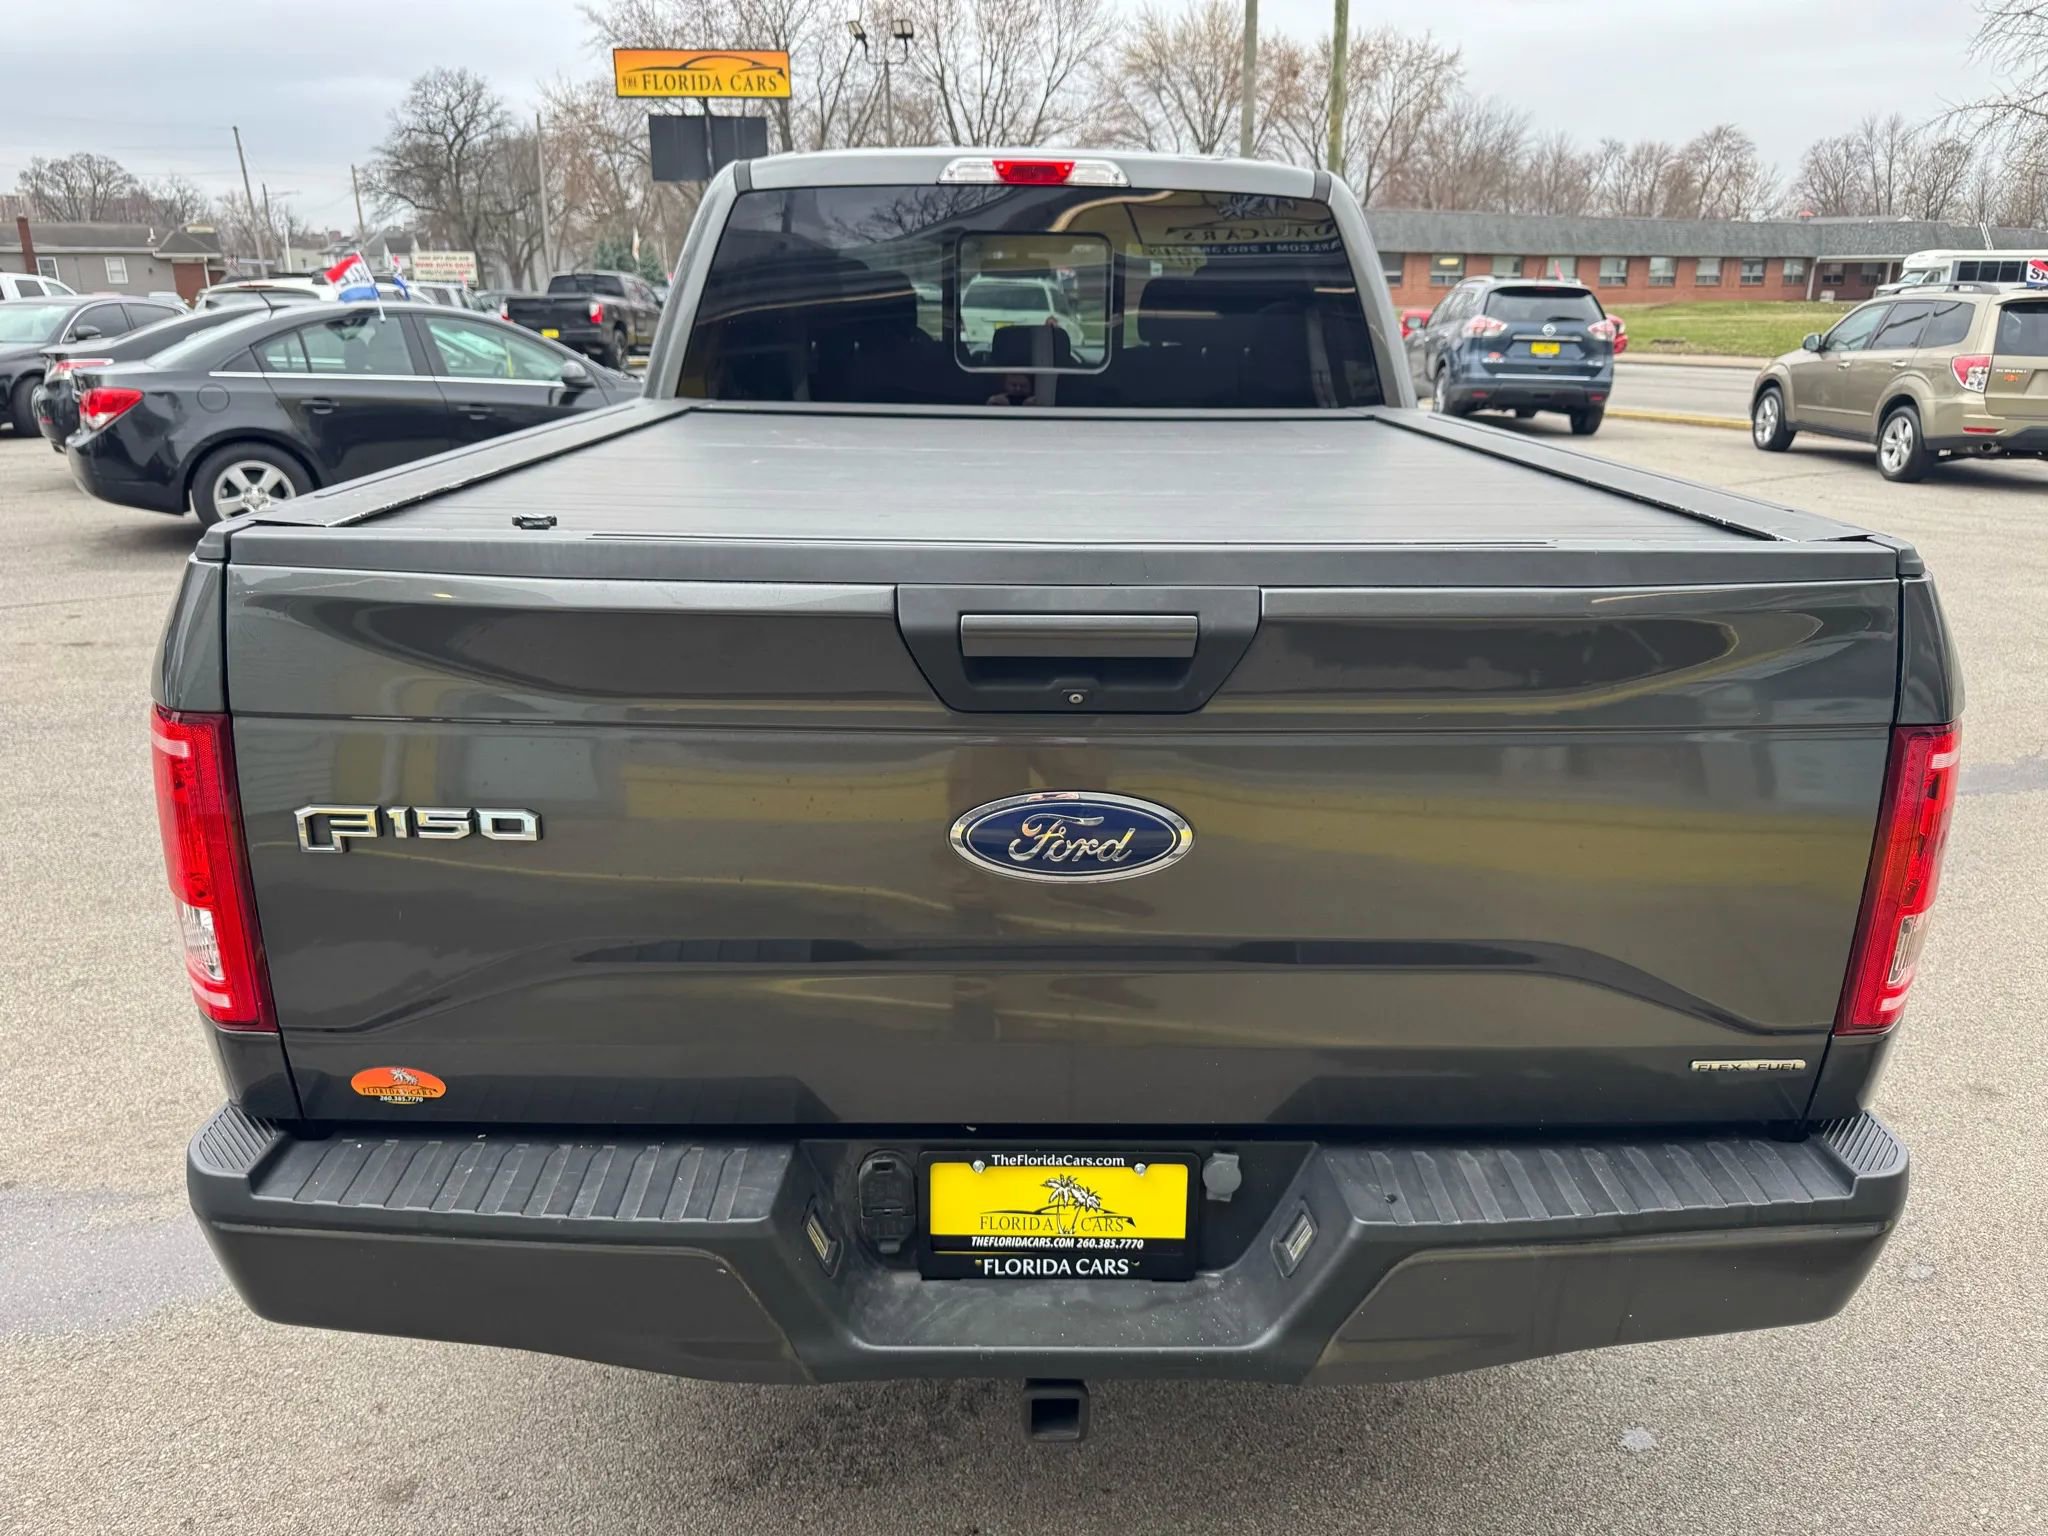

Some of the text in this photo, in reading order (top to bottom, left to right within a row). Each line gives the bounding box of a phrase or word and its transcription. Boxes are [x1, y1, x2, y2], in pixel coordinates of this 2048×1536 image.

[642, 74, 723, 91] FLORIDA
[730, 75, 777, 91] CARS
[1008, 813, 1135, 862] Ford
[1697, 1063, 1802, 1072] FLEX FUEL
[991, 1154, 1125, 1167] TheFloridaCars.com
[980, 1215, 1124, 1232] FLORIDA CARS
[971, 1236, 1144, 1249] THEFLORIDACARS.COM 260.385.7770
[984, 1259, 1129, 1276] FLORIDA CARS
